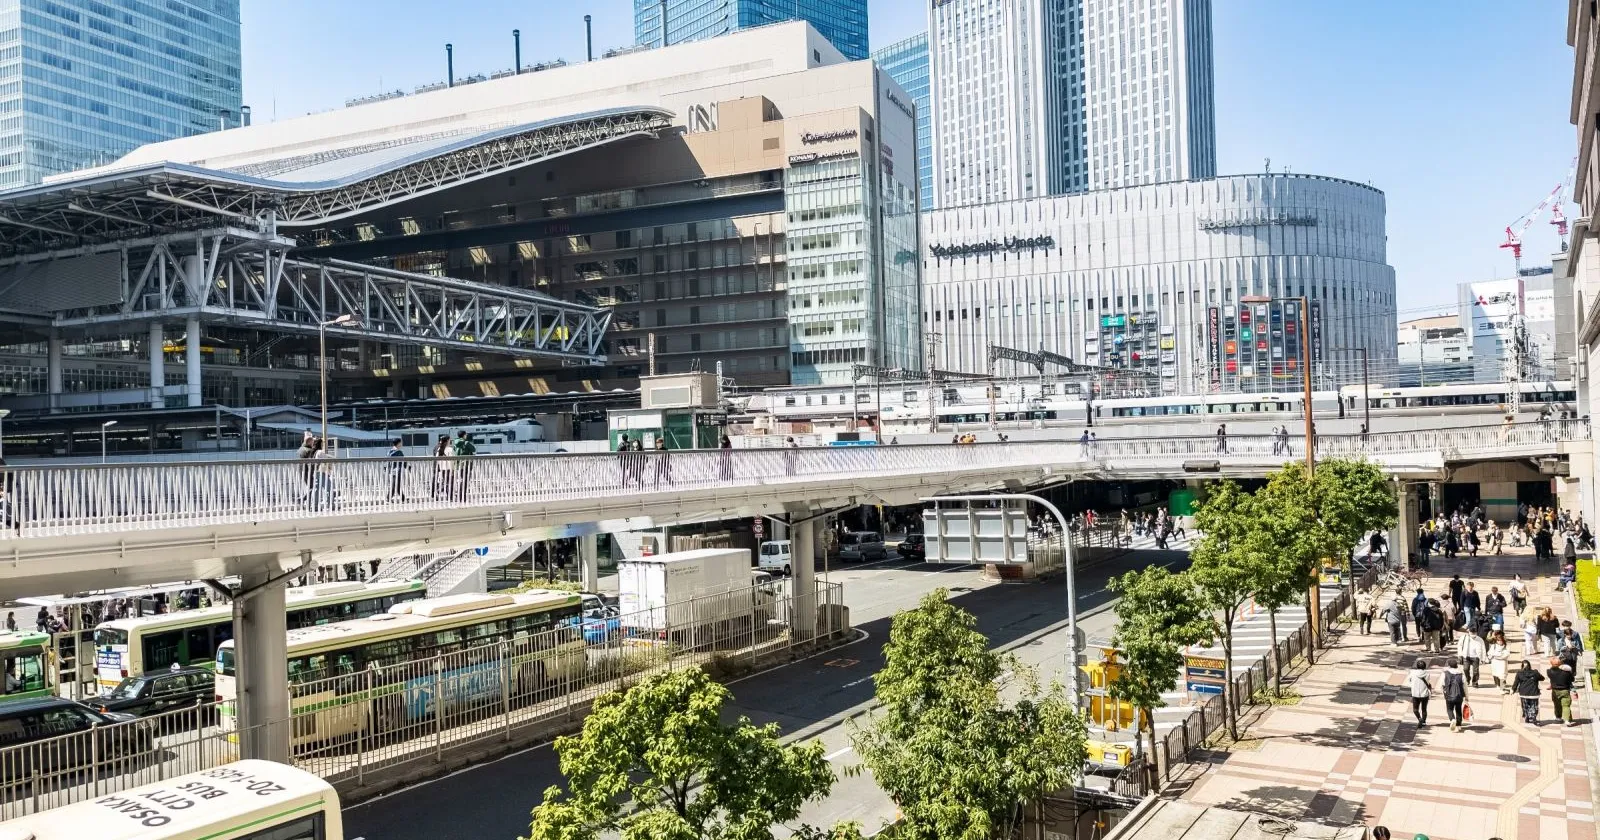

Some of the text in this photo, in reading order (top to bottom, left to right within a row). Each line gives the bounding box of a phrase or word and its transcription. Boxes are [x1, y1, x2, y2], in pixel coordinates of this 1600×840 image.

[929, 234, 1052, 256] Yodobashi-Umeda
[138, 790, 195, 810] CITY
[176, 781, 228, 800] BUS
[96, 796, 171, 827] OSAKA
